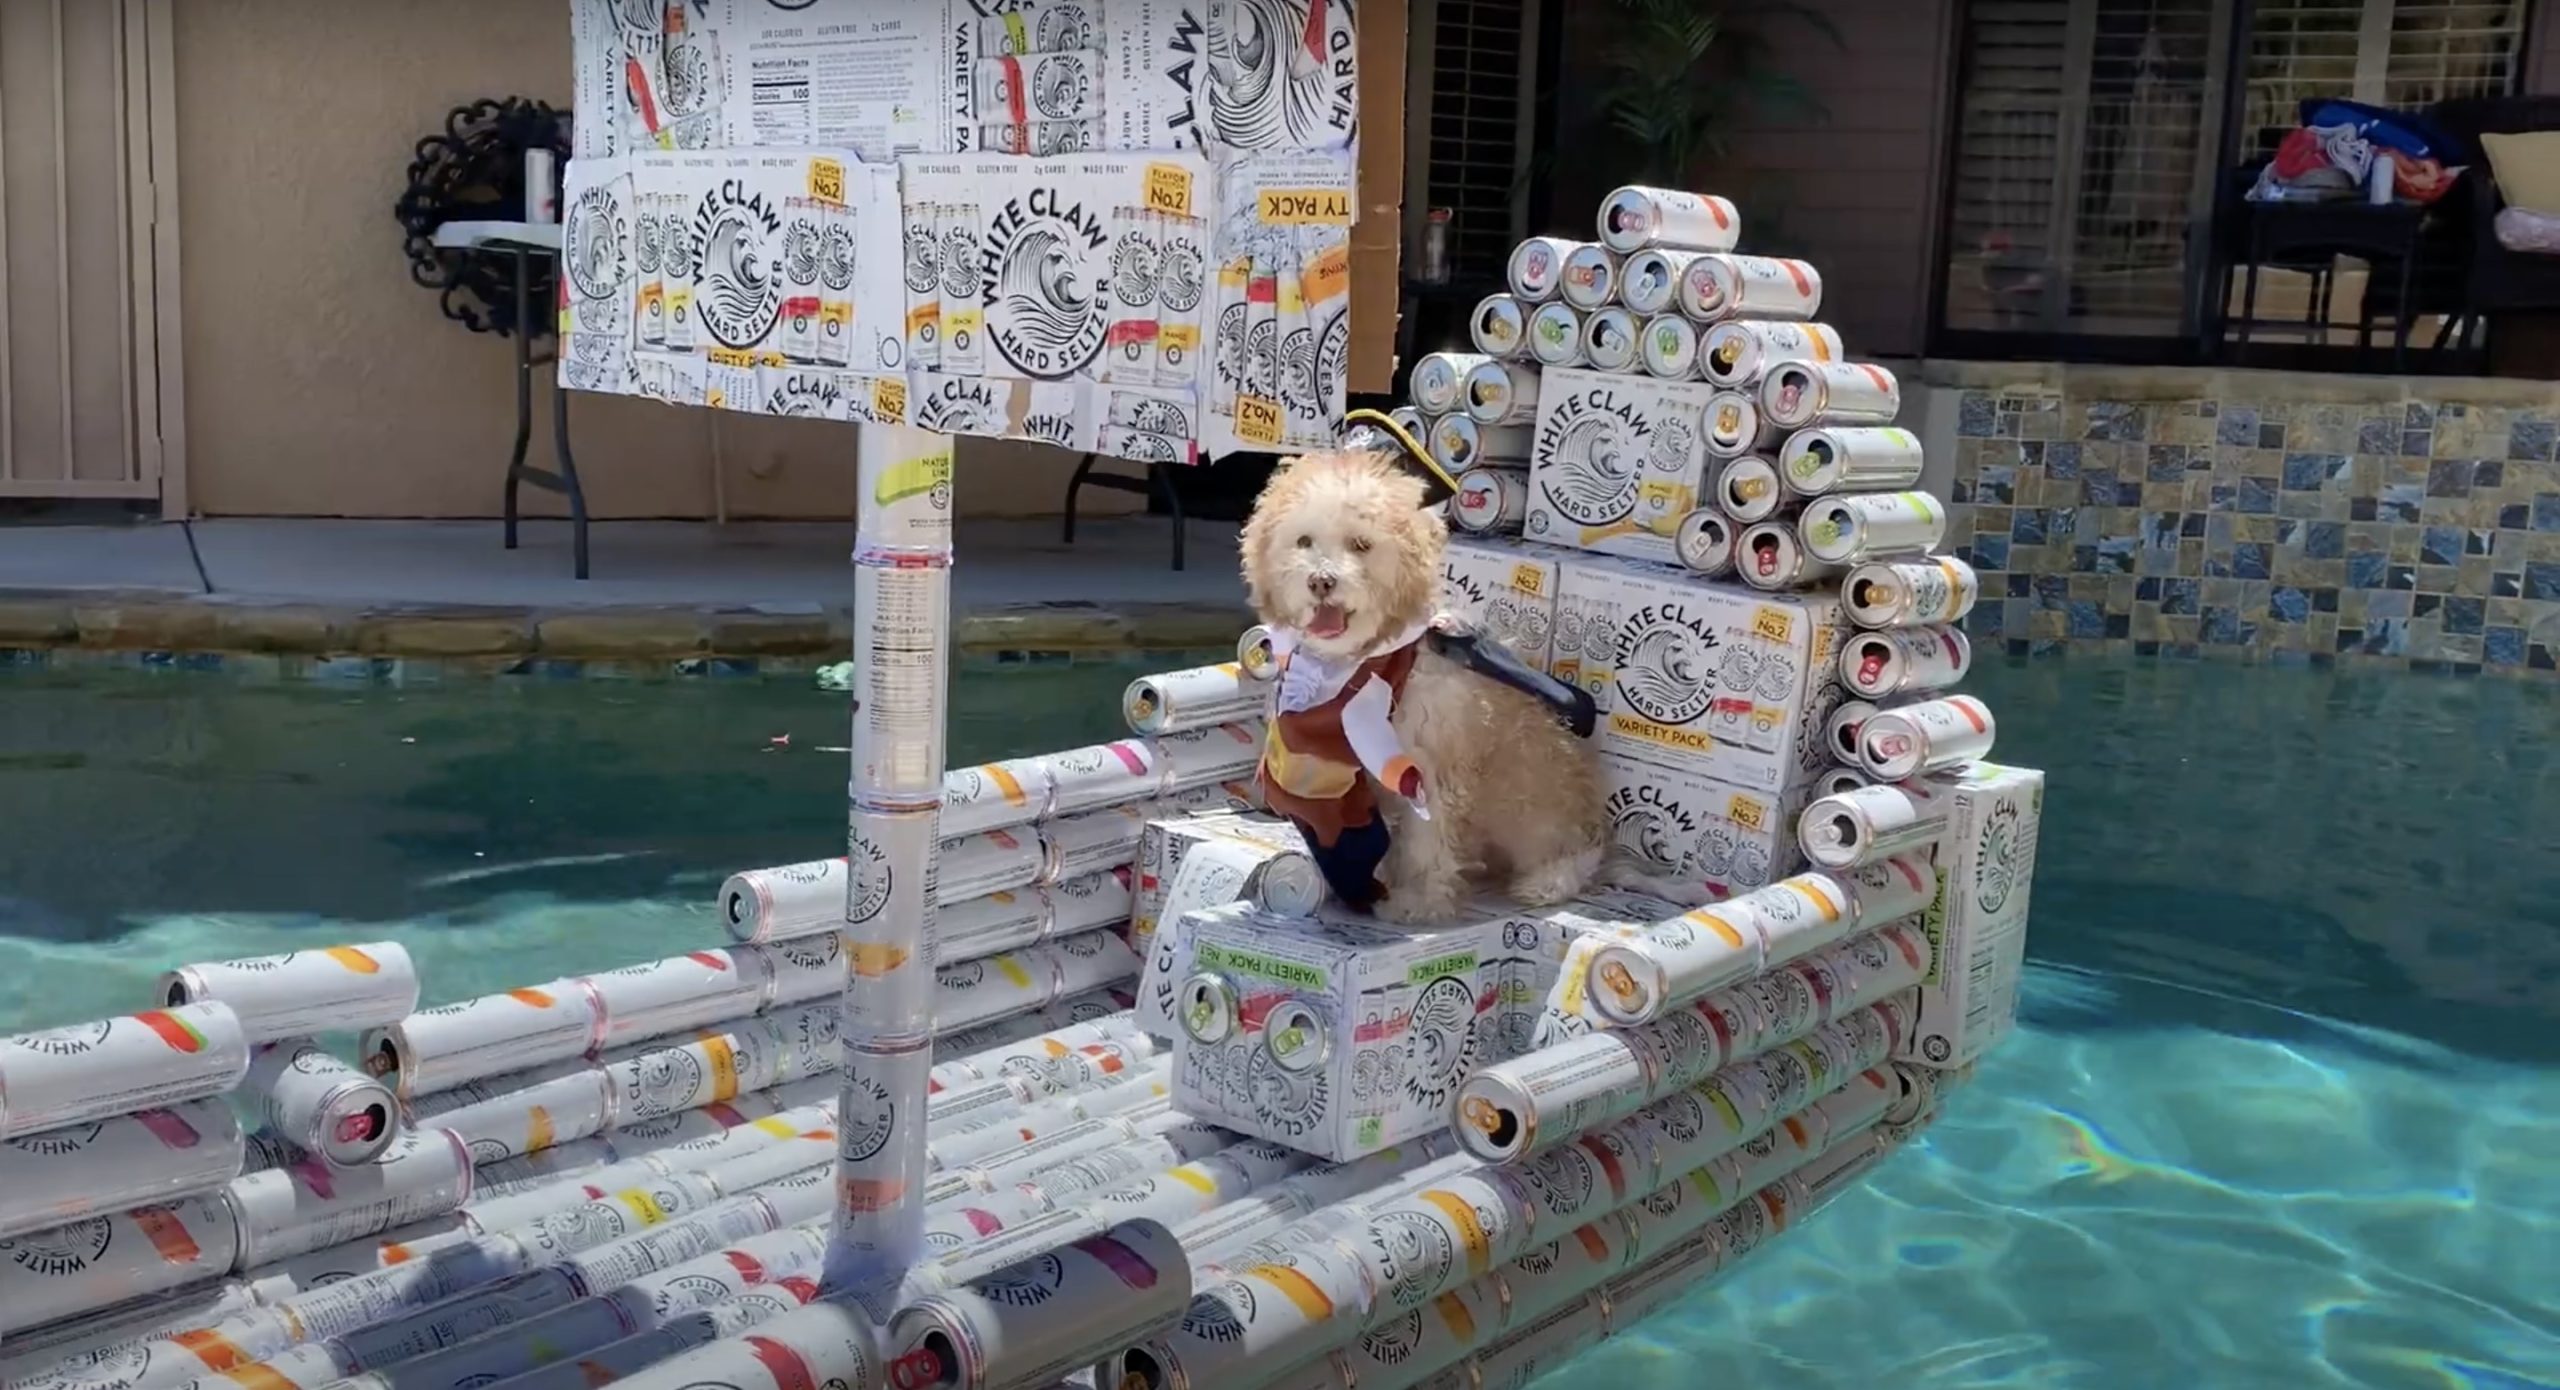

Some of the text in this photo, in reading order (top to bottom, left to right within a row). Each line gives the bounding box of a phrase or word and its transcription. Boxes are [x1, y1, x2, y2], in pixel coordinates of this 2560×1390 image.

[955, 21, 969, 120] VARIETY
[1329, 29, 1354, 130] HARD
[605, 47, 615, 127] VARIETY
[813, 178, 840, 199] No.2
[1152, 168, 1185, 183] FLAVOR
[1150, 186, 1184, 209] No.2
[1267, 196, 1317, 217] PACK
[691, 178, 782, 287] WHITE CLAW
[982, 187, 1109, 309] WHITE CLAW
[706, 259, 783, 342] HARD SELTZER
[1001, 277, 1110, 370] HARD SELTZER
[877, 395, 906, 417] No.2
[1242, 402, 1276, 425] No.2
[1022, 414, 1075, 447] WHIT
[1537, 389, 1651, 471] WHITE CLAW
[1551, 486, 1592, 519] HARD
[1439, 563, 1485, 605] LAW
[1514, 574, 1539, 592] No.2
[1613, 602, 1720, 671] WHITE CLAW
[1756, 619, 1785, 638] No.2
[1627, 667, 1718, 720] HARD SELTZER
[1615, 716, 1707, 750] VARIETY PACK
[1765, 765, 1778, 781] 12
[1638, 785, 1696, 833] CLAW
[1731, 808, 1760, 827] No.2
[1930, 872, 1946, 912] PACK
[784, 950, 826, 969] WHITE
[1228, 953, 1319, 985] VARIETY PACK
[1436, 956, 1476, 973] VARIETY
[1440, 983, 1469, 1006] HARD
[13, 1036, 91, 1056] WHITE
[1255, 1071, 1329, 1137] WHITE CLAW
[1405, 1076, 1445, 1112] CLAW
[1660, 1120, 1697, 1144] WHITE
[15, 1249, 87, 1277] WHITE
[1368, 1225, 1396, 1281] CLAW
[1179, 1318, 1248, 1344] WHITE
[1361, 1336, 1411, 1366] WHITE
